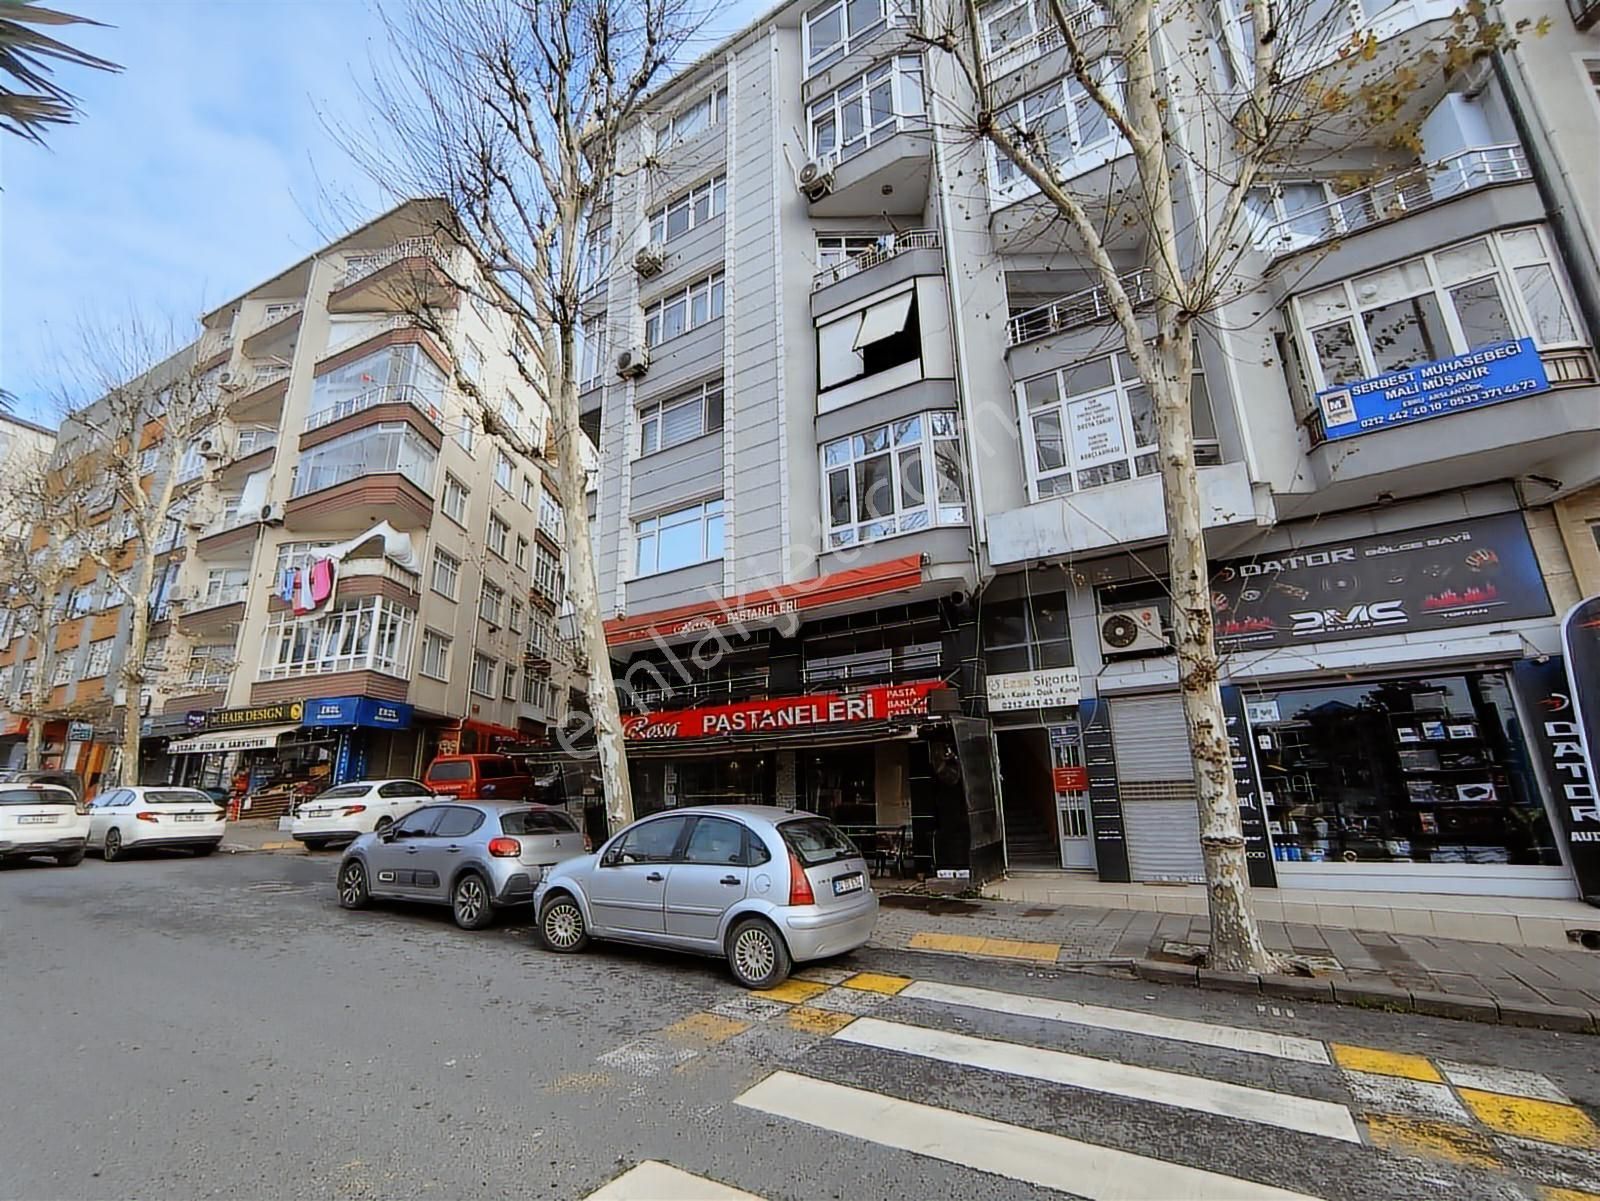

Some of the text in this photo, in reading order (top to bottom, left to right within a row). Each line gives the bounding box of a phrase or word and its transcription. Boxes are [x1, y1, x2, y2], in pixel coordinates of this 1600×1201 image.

[1352, 342, 1522, 395] SERBEST MUHASEBECİ
[1385, 366, 1490, 400] MALİ MÜŞAVİR
[1360, 416, 1384, 428] 0212
[1388, 409, 1408, 421] 442
[1413, 405, 1428, 416] 40
[1430, 401, 1442, 413] 10
[1449, 394, 1479, 407] 0533
[1482, 387, 1502, 399] 371
[1239, 547, 1356, 577] DATOR
[886, 688, 917, 699] PASTA
[1033, 673, 1078, 688] Sigorta
[220, 710, 244, 723] HAIR
[245, 706, 284, 722] DESIGN
[702, 694, 875, 735] PASTANELERİ
